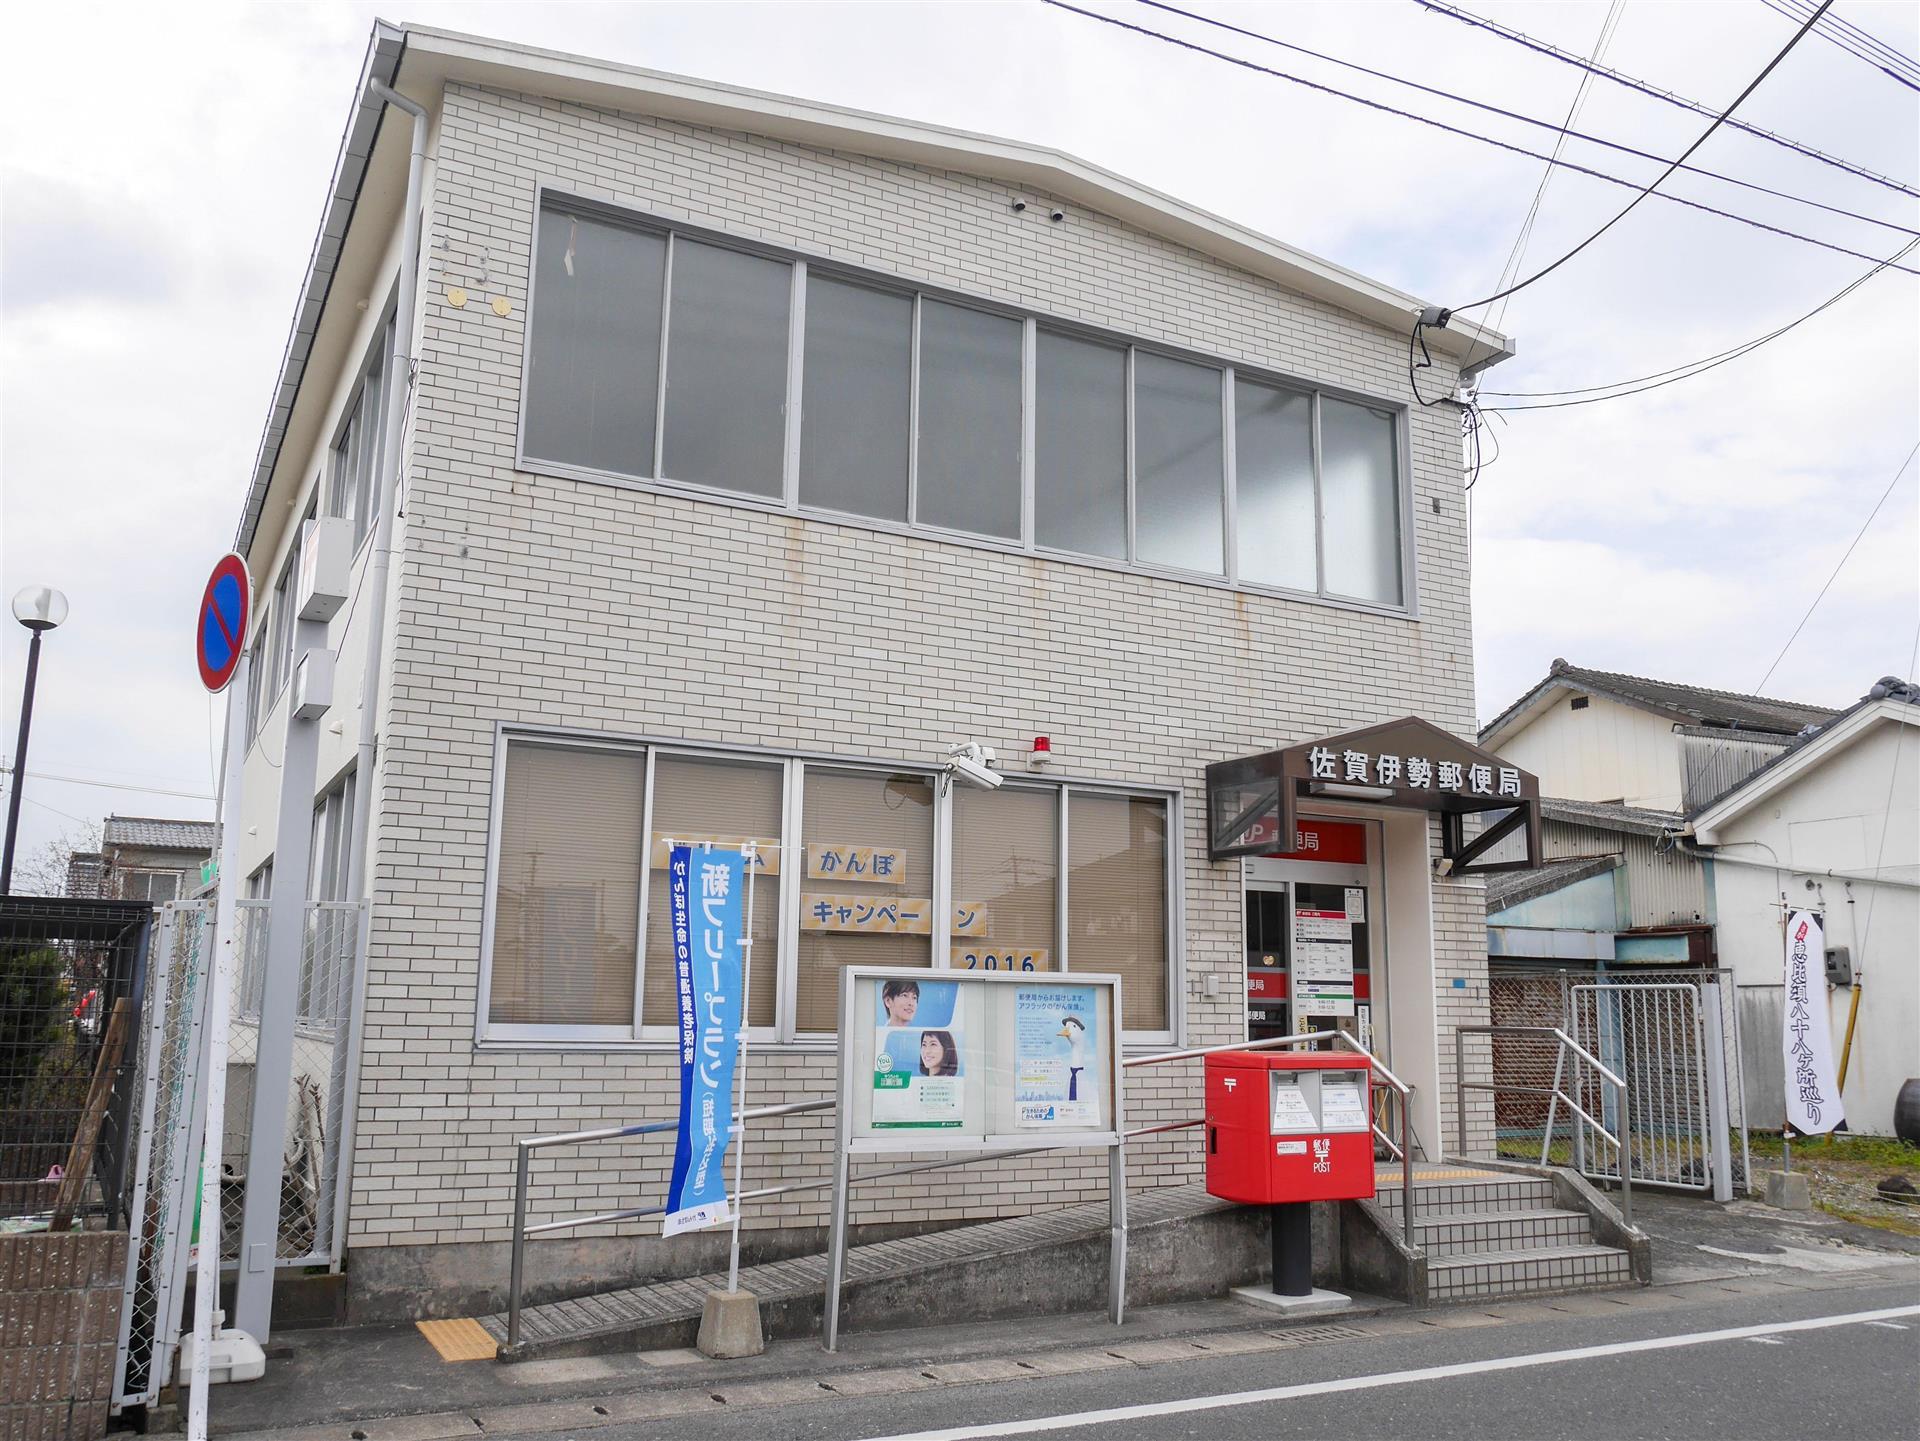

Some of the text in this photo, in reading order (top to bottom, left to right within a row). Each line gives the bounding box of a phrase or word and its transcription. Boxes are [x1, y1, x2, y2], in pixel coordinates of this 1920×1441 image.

[1309, 747, 1522, 797] 佐賀伊勢郵便局
[820, 850, 896, 876] かんぽ
[964, 954, 1035, 972] 2016
[1312, 1139, 1331, 1151] 郵便
[1313, 1162, 1331, 1173] POST
